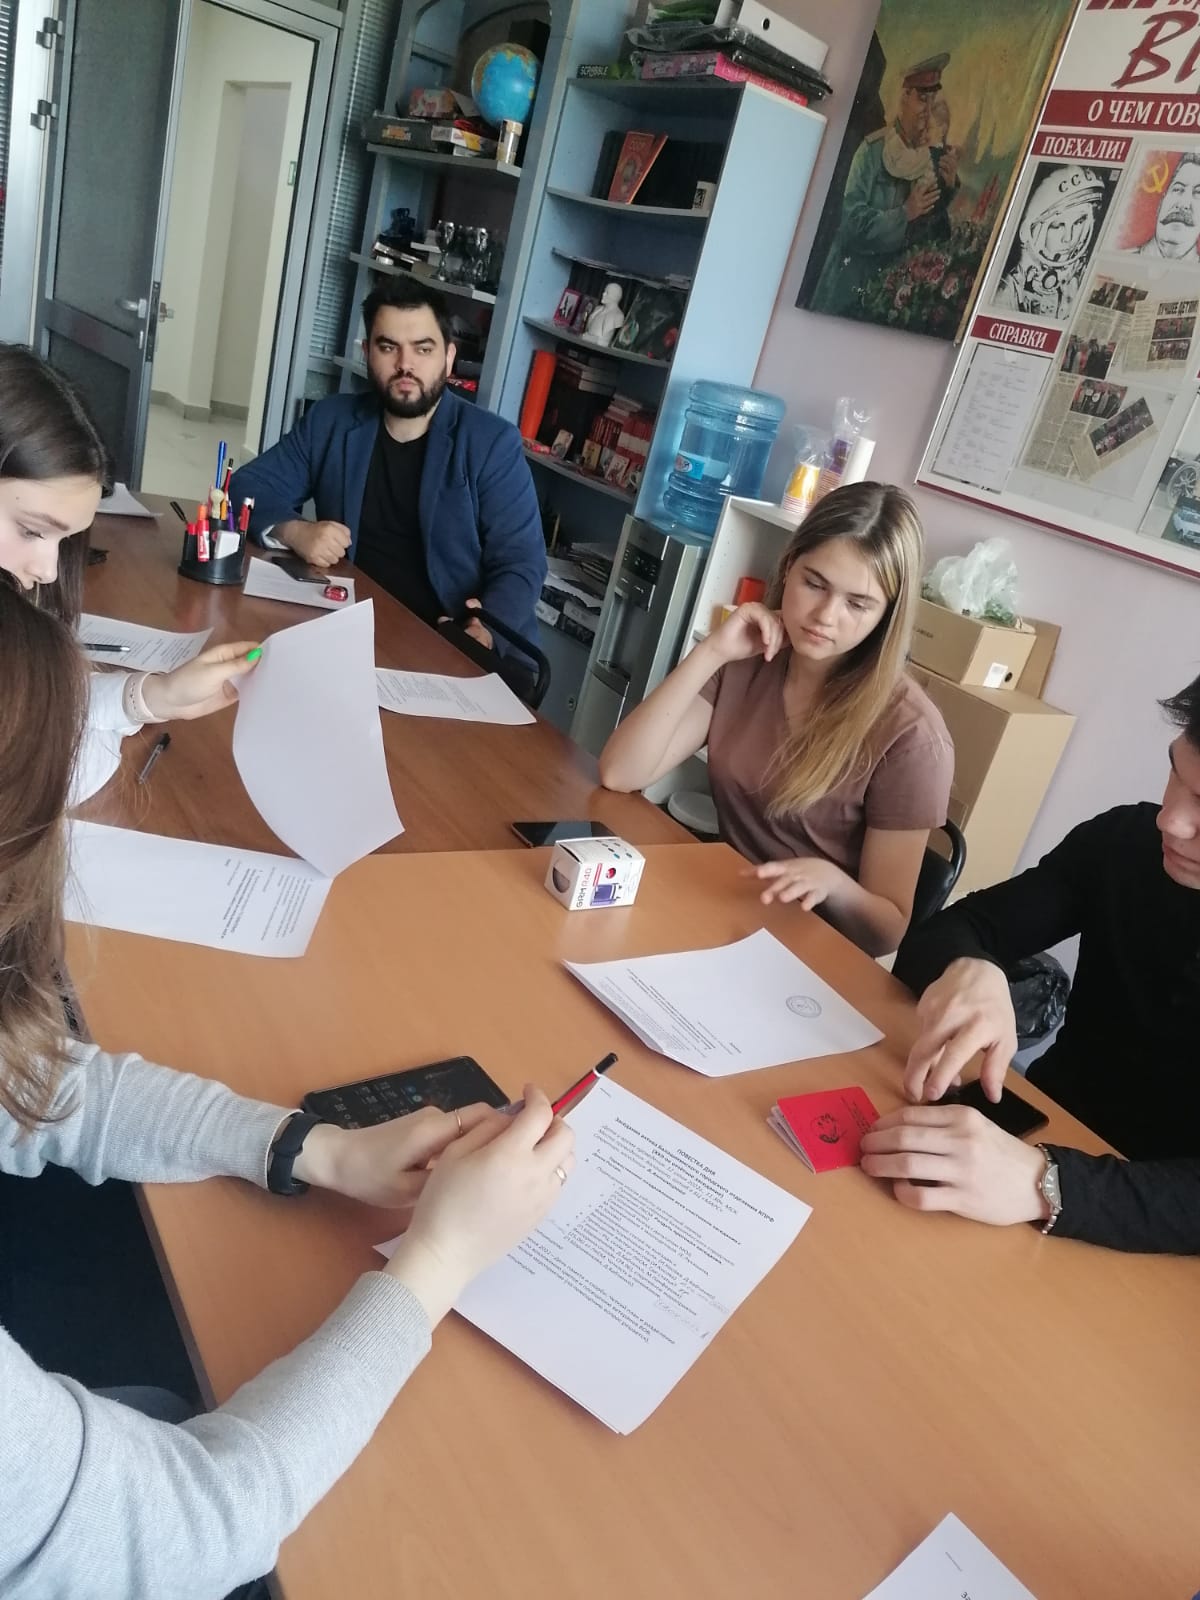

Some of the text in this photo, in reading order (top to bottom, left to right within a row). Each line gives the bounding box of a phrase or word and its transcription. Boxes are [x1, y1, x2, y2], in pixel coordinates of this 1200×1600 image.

[1088, 99, 1200, 126] О ЧЕМ ГОВ
[1041, 136, 1126, 160] ПОЕХАЛИ!
[989, 322, 1049, 349] СПРАВКИ
[676, 1148, 716, 1177] ПОВЕСТКА ДНЯ
